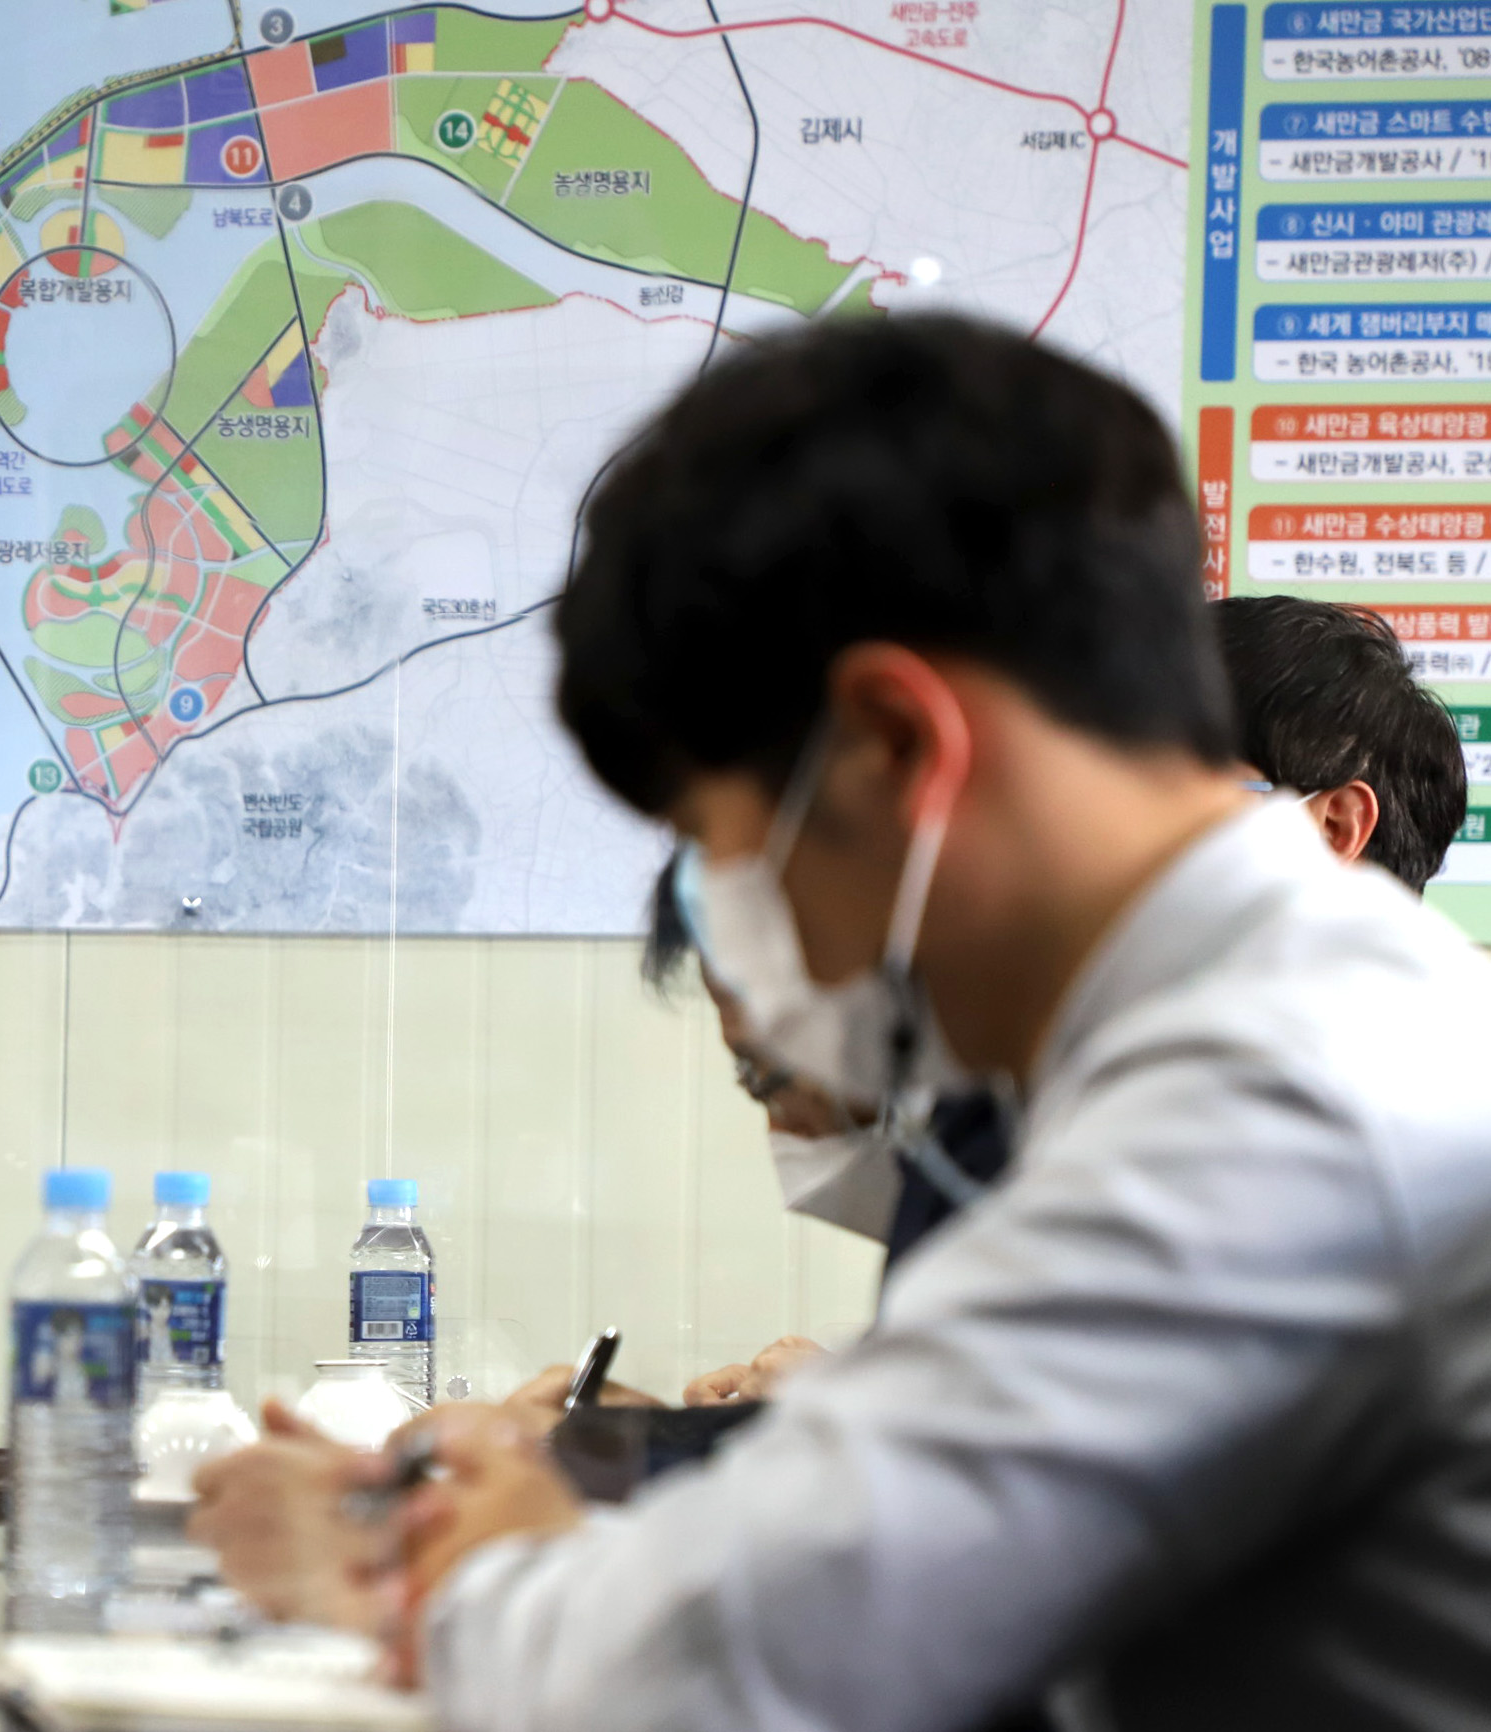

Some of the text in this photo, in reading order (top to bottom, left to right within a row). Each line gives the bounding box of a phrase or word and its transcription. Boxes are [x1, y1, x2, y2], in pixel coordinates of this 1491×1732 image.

[1317, 9, 1383, 35] 새만금
[907, 28, 968, 49] 고속도로
[445, 121, 470, 140] 14
[800, 117, 863, 144] 김제시
[1313, 110, 1379, 136] 새만금
[1386, 109, 1454, 135] 스마트
[1070, 131, 1086, 149] IC
[230, 147, 253, 166] 11
[1289, 148, 1442, 174] 새만금개발공사
[554, 169, 650, 197] 농생명용지
[1210, 129, 1238, 260] 개발사업
[212, 207, 274, 229] 남북도로
[1312, 211, 1354, 236] 신시
[1379, 210, 1424, 236] 야미
[1286, 248, 1476, 275] 새만금관광레저(주)
[18, 278, 131, 302] 복합개발용지
[1360, 311, 1468, 337] 잼버리부지
[1297, 351, 1337, 375] 한국
[217, 415, 310, 439] 농생명용지
[1305, 412, 1369, 438] 새만금
[1378, 411, 1487, 438] 육상태양광
[1302, 512, 1367, 538] 새만금
[1375, 512, 1485, 538] 수상태양광
[1375, 551, 1438, 575] 전북도
[1448, 552, 1466, 575] 등
[34, 767, 57, 787] 13
[243, 817, 302, 838] 국립공원
